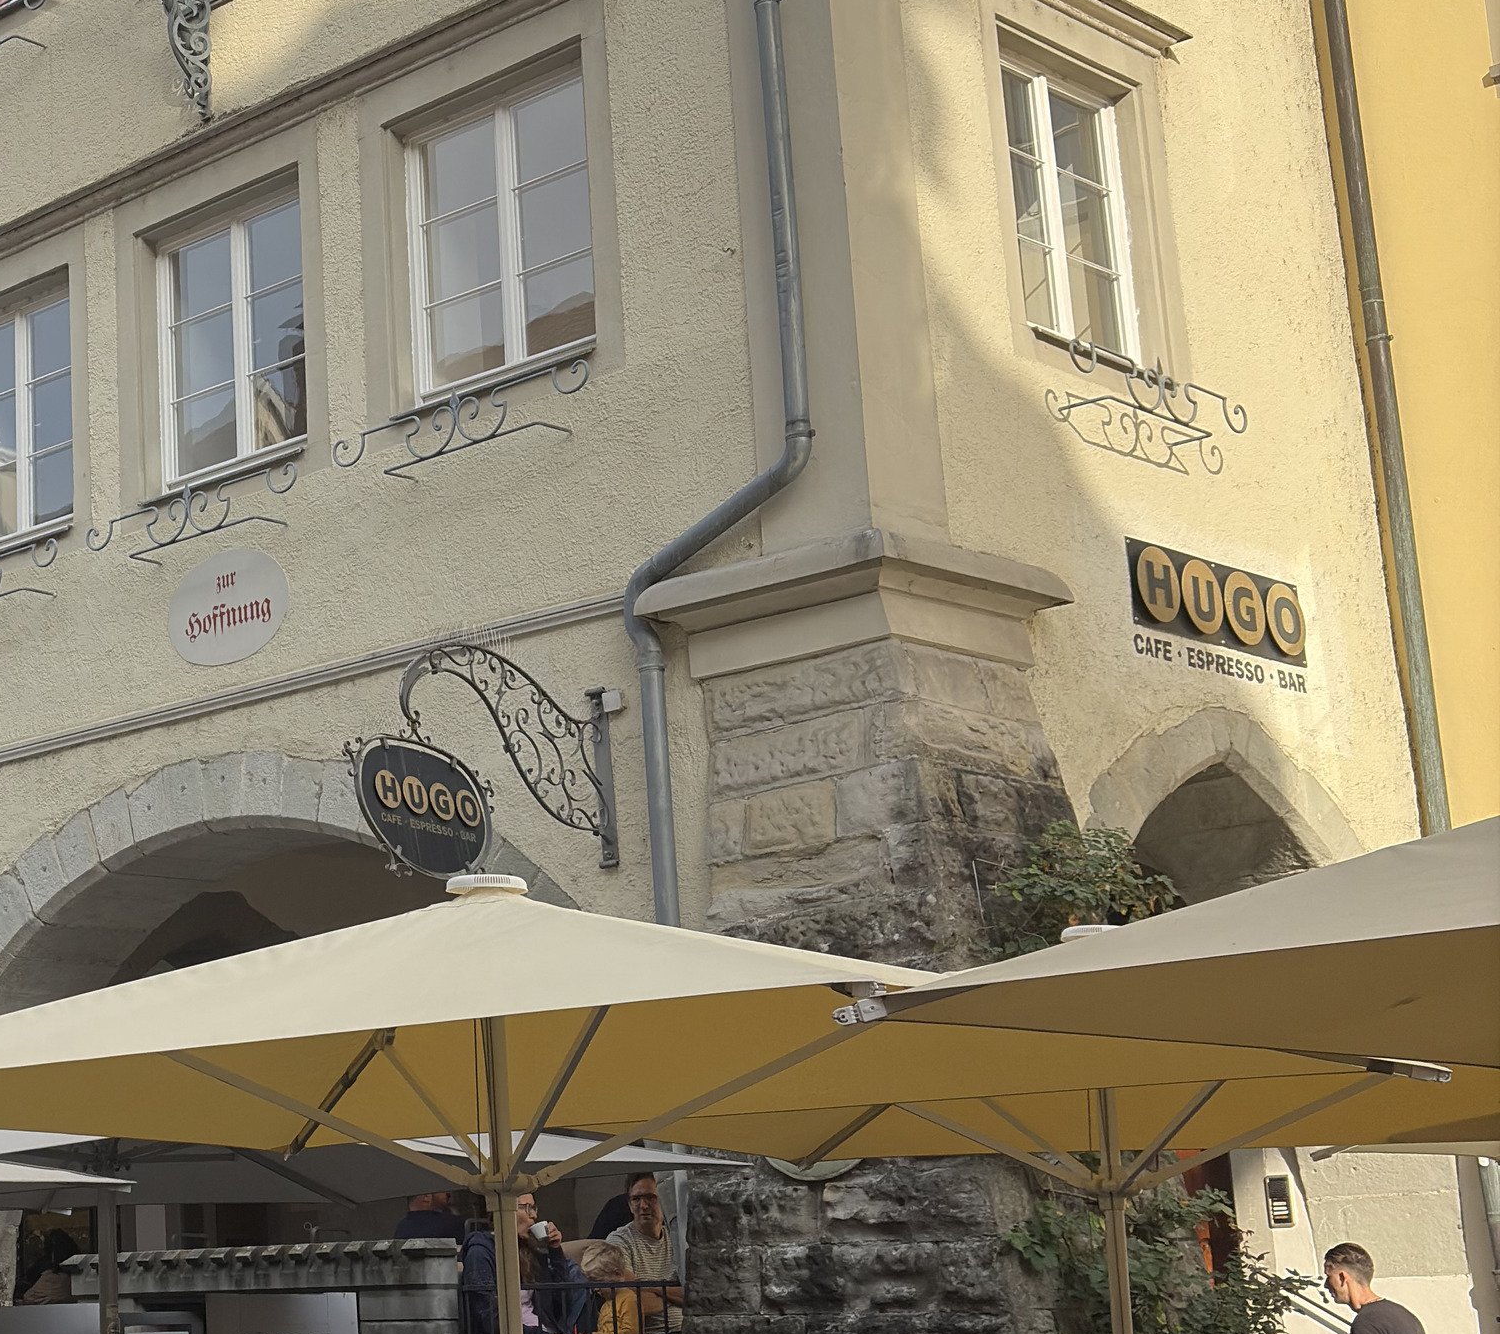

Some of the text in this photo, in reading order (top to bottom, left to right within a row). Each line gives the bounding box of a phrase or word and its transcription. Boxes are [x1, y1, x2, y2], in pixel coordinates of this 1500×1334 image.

[216, 571, 236, 594] zur
[1140, 554, 1303, 649] HUGO
[185, 597, 272, 644] Hoffnung
[1133, 633, 1307, 694] CAFE ESPRESSO BAR
[377, 771, 478, 824] HUGO
[381, 812, 477, 843] CAFE ESPRESSO BAR
